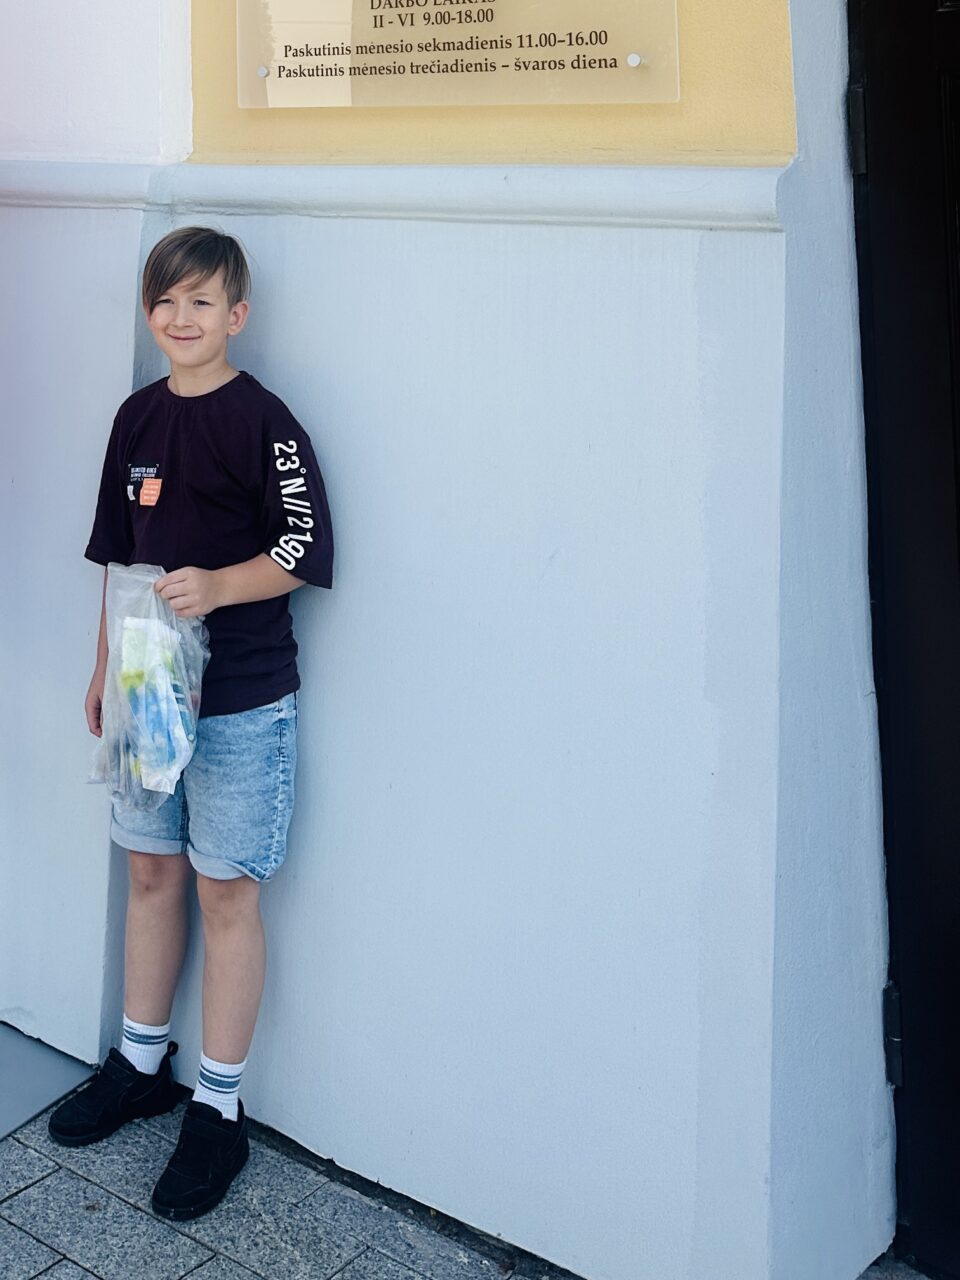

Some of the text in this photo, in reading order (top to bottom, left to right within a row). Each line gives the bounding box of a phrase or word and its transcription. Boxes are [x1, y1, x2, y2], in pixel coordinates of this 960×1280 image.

[372, 14, 384, 29] II
[395, 12, 415, 27] VI
[422, 8, 494, 26] 9.00-18.00
[283, 41, 352, 58] Paskutinis
[355, 39, 413, 55] mėnesio
[417, 34, 512, 53] sekmadienis
[277, 62, 345, 78] Paskutinis
[348, 60, 406, 76] mėnesio
[410, 57, 497, 74] trečiadienis
[514, 56, 566, 72] švaros
[570, 54, 618, 70] diena
